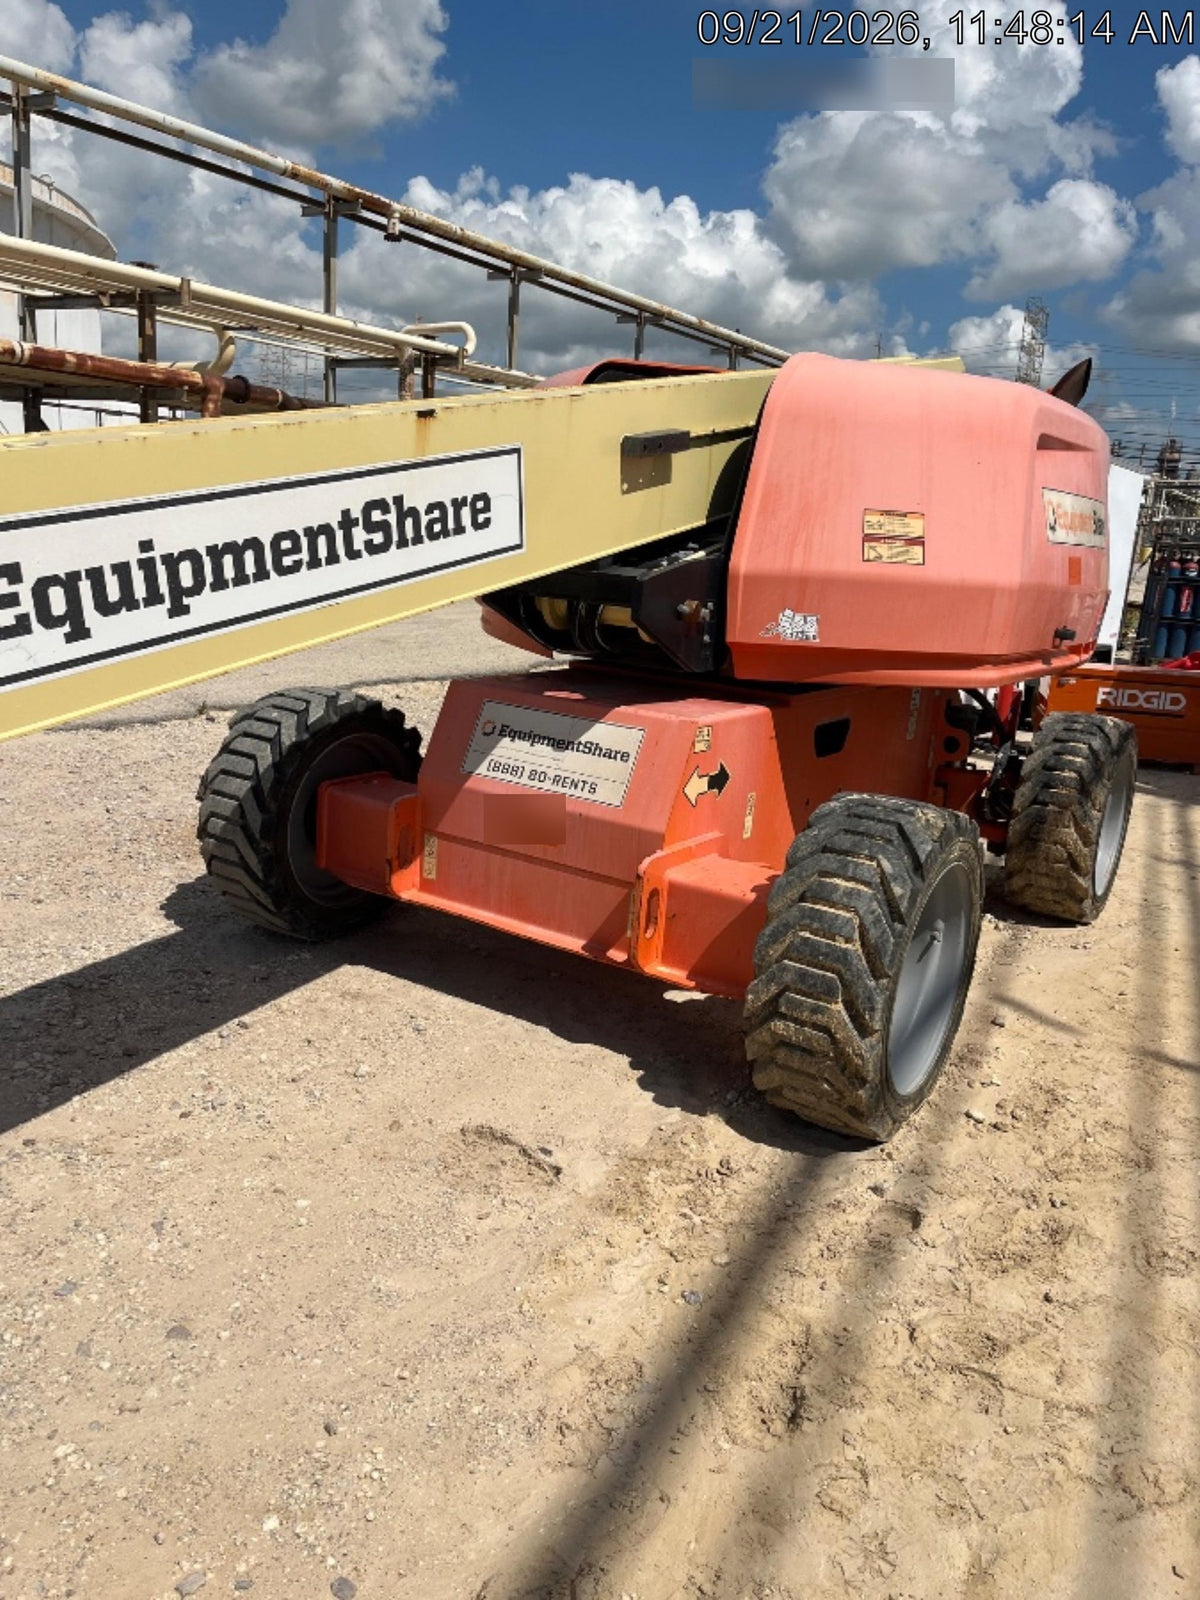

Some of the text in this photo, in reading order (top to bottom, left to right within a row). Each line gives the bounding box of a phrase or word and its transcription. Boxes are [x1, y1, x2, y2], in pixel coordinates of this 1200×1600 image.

[1096, 686, 1187, 711] RIDGID
[498, 724, 630, 763] EquipmentShare
[527, 769, 598, 796] 80-RENTS
